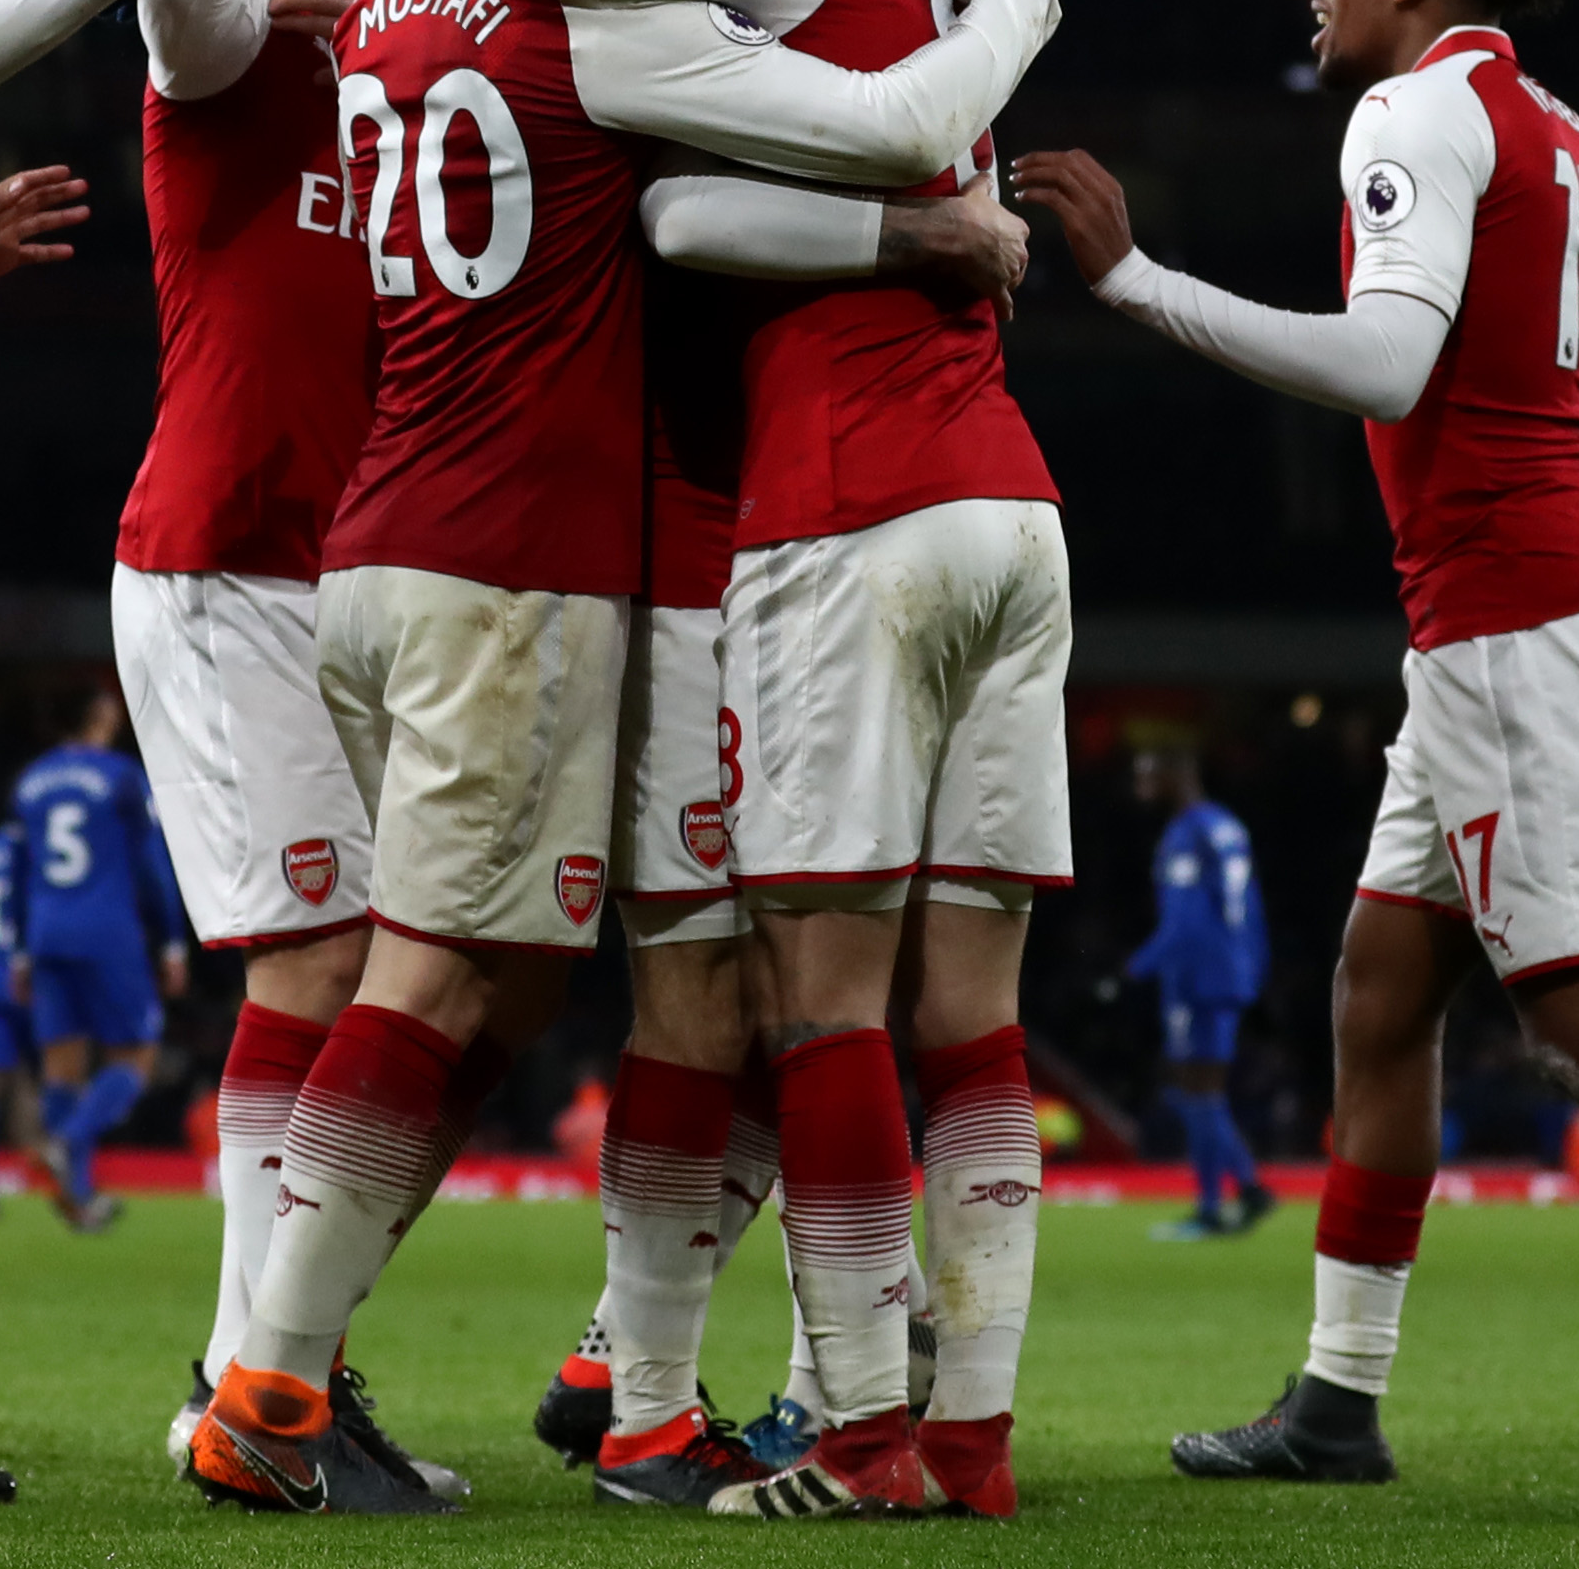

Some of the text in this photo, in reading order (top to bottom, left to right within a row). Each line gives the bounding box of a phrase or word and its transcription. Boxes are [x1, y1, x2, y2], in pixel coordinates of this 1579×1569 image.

[337, 67, 534, 300] 20
[42, 800, 93, 889] 5
[688, 812, 723, 824] Arsen
[1445, 810, 1501, 919] 17
